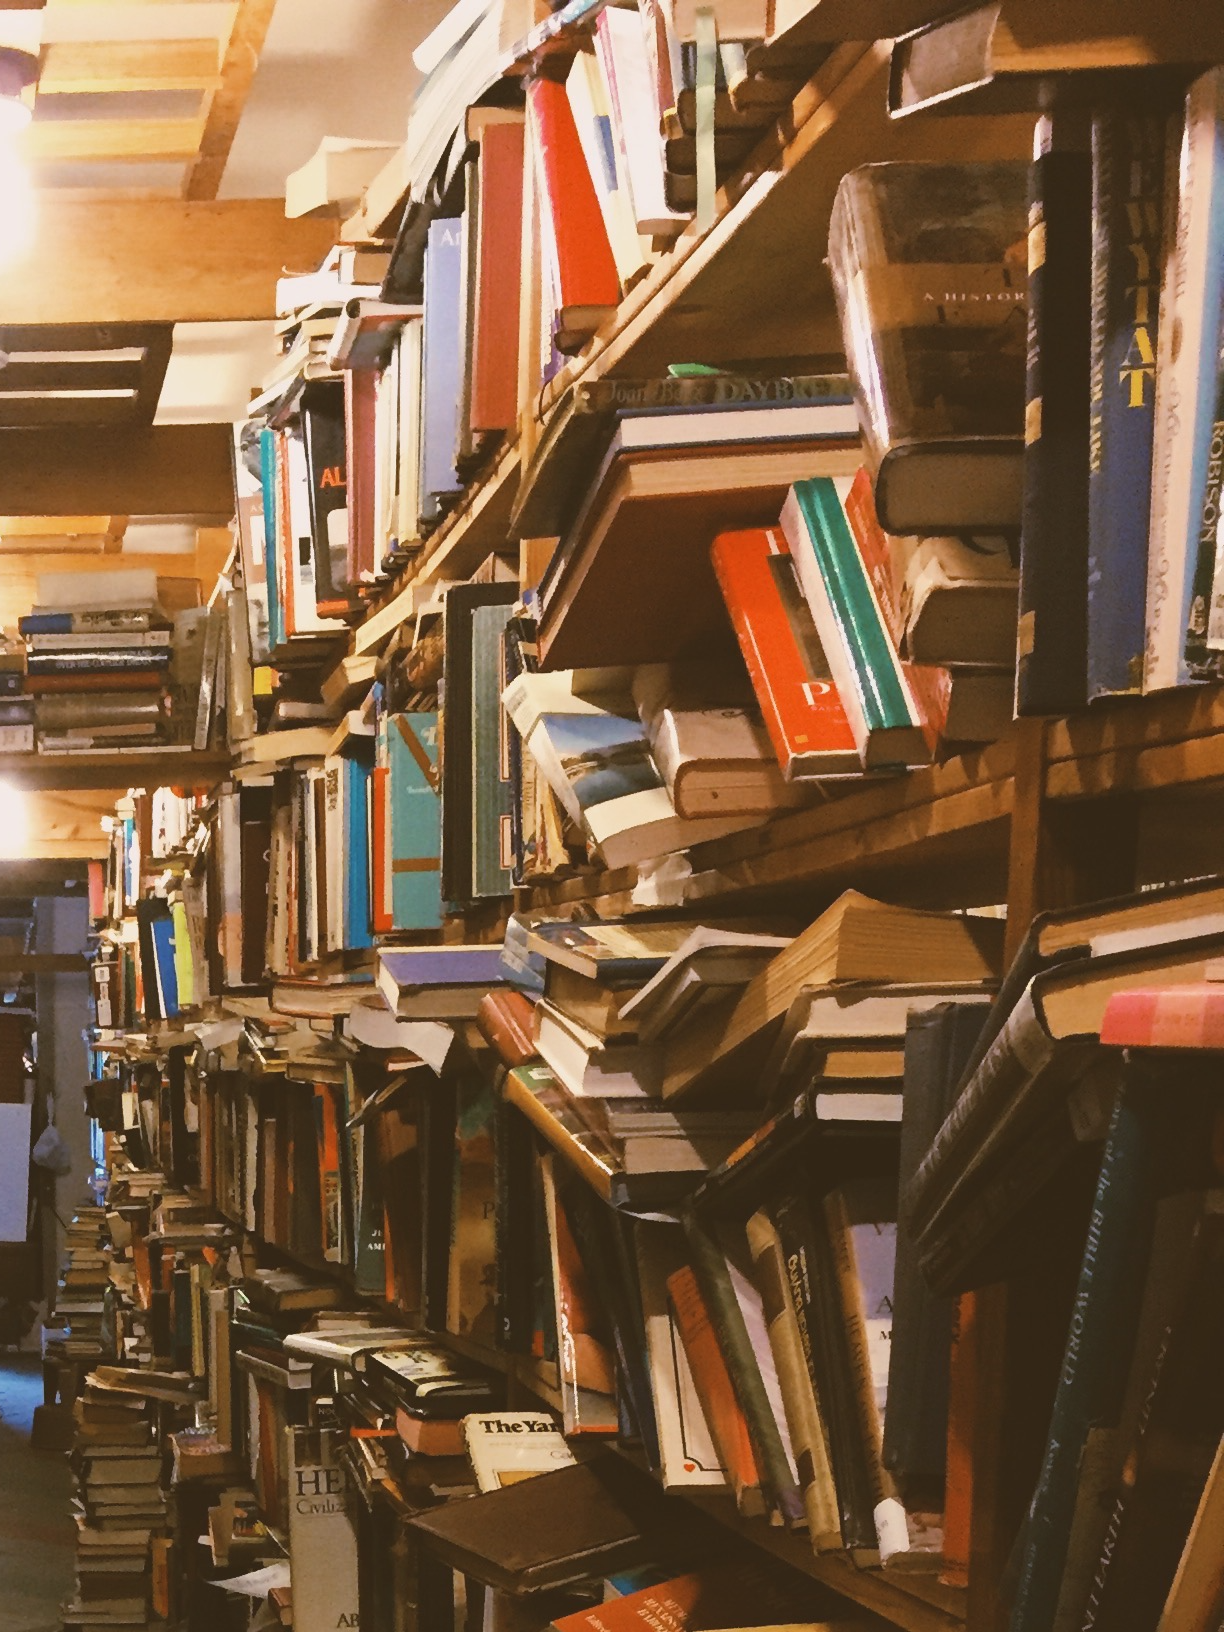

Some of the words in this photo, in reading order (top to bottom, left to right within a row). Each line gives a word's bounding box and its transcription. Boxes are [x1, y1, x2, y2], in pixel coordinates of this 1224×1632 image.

[1199, 419, 1224, 544] ROBISON
[1080, 1208, 1105, 1282] BIBLE
[1062, 1292, 1090, 1386] WORLD
[478, 1419, 524, 1434] The
[296, 1468, 346, 1497] HE
